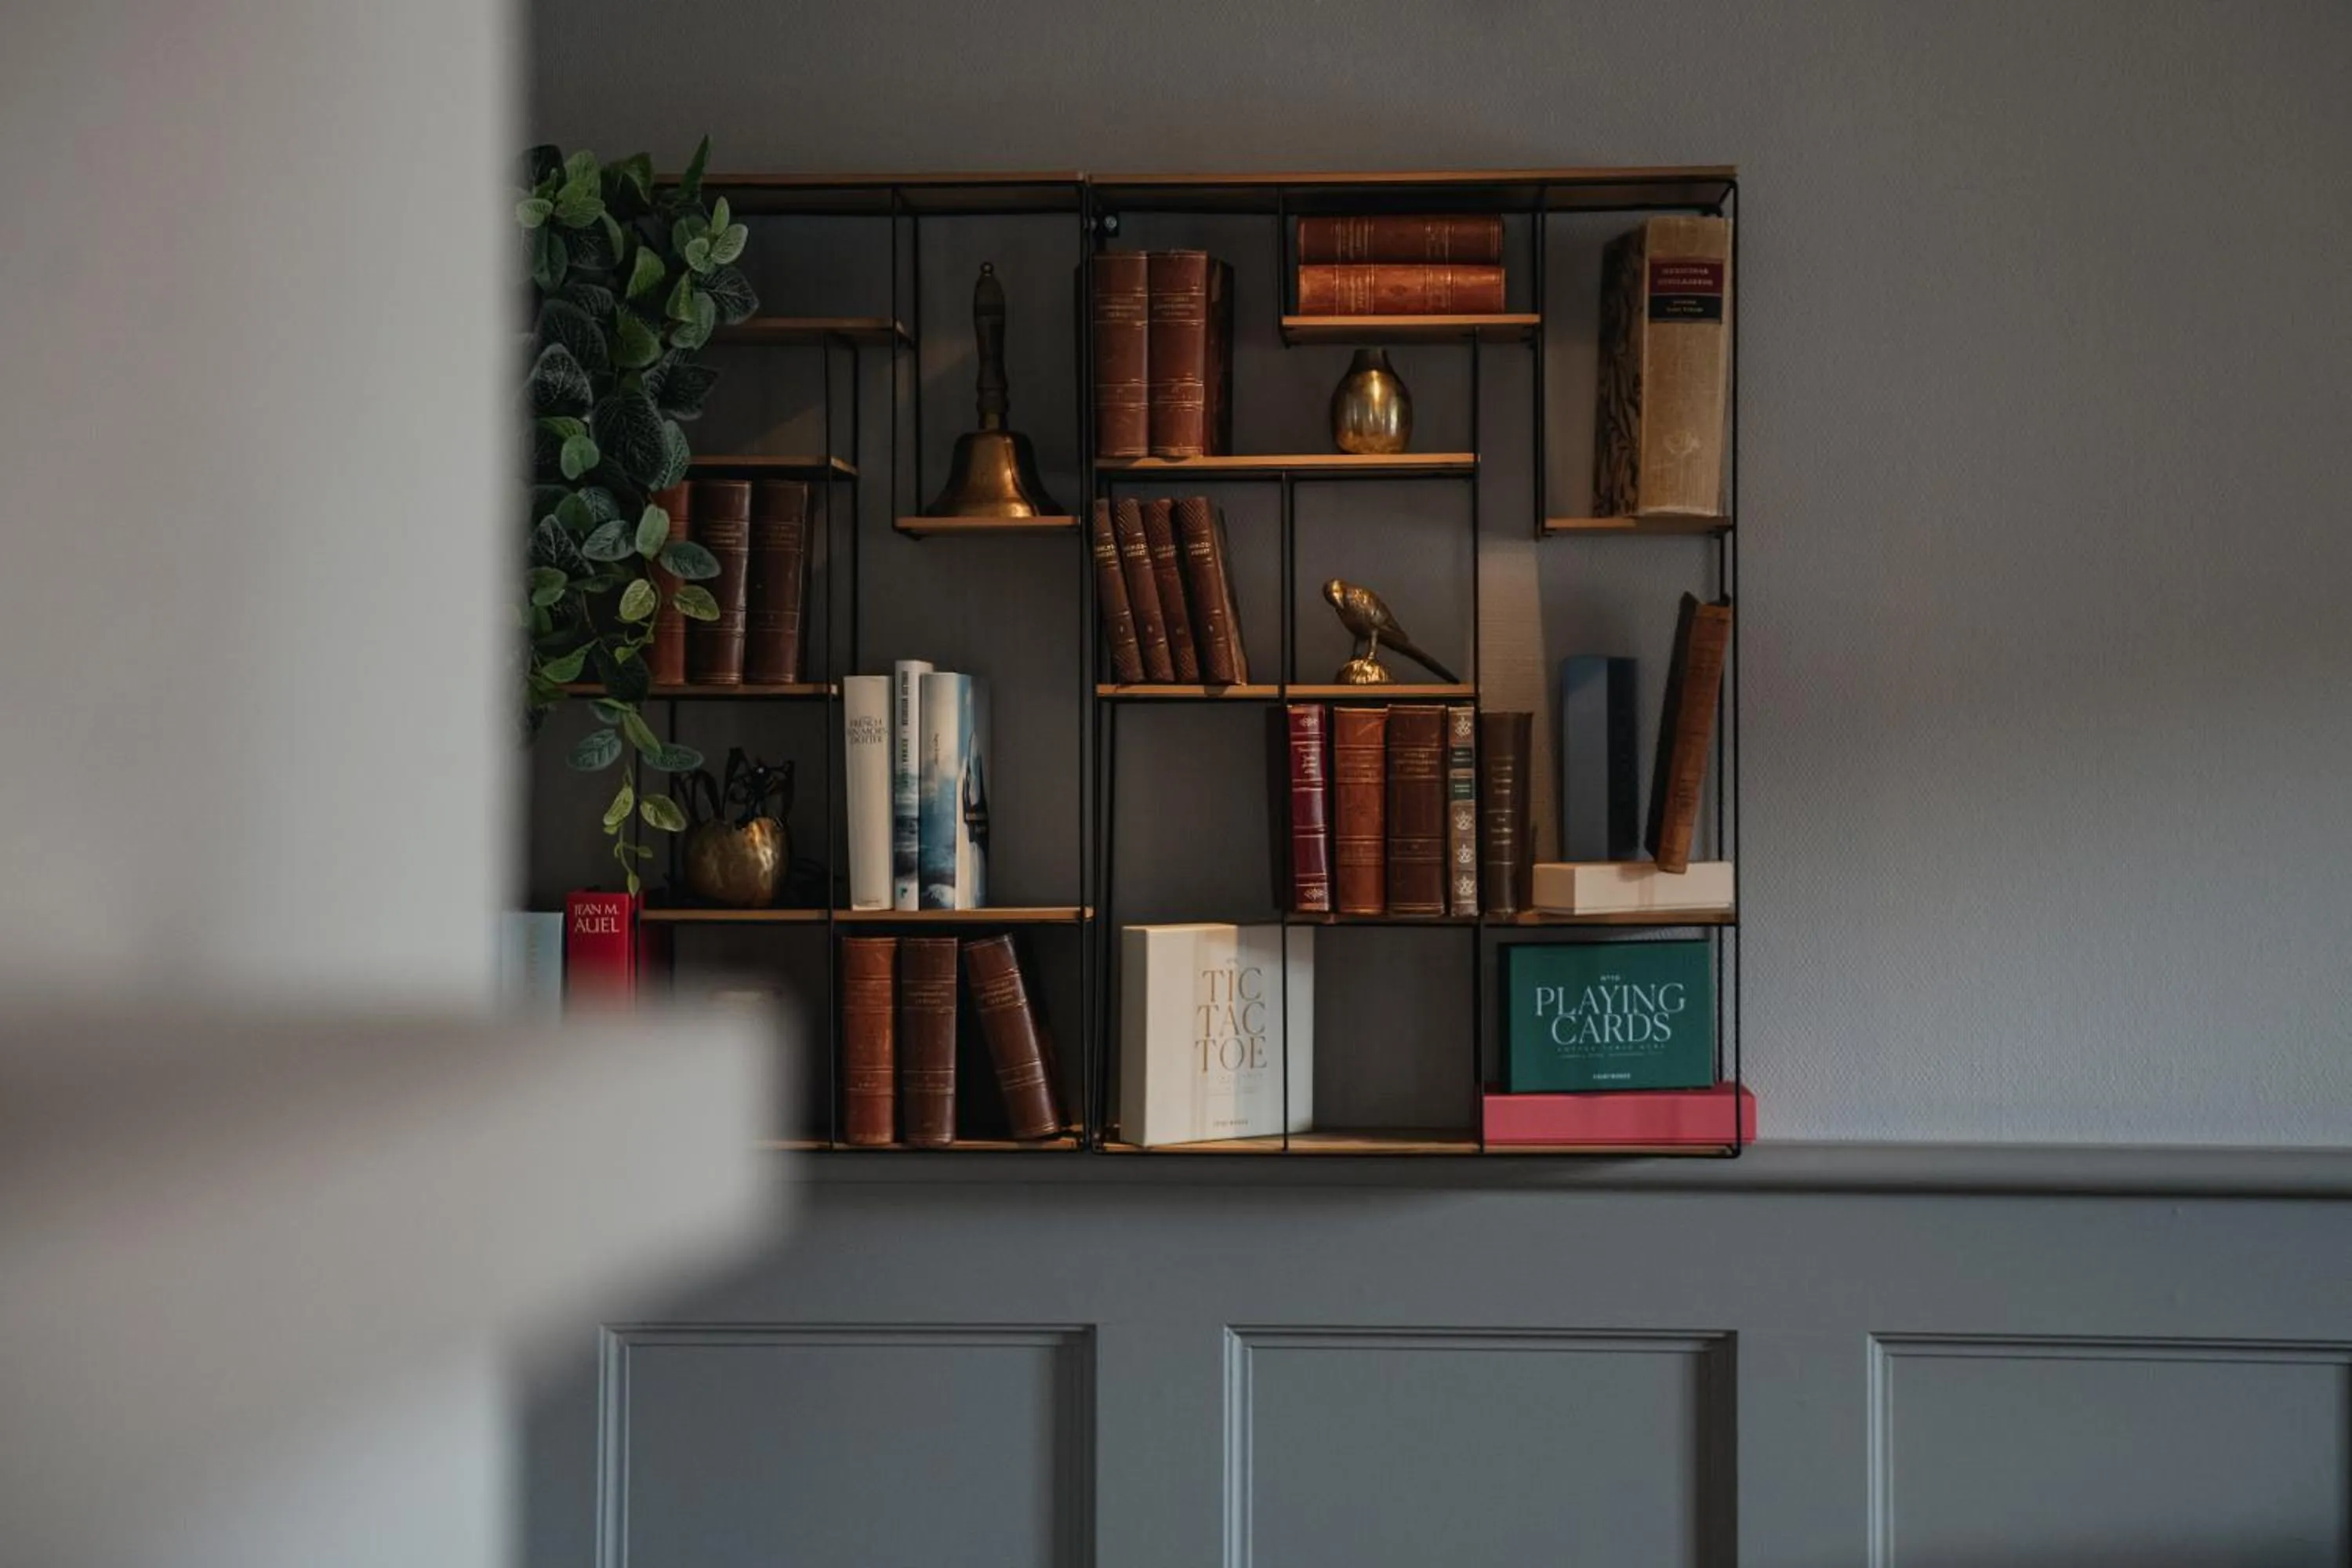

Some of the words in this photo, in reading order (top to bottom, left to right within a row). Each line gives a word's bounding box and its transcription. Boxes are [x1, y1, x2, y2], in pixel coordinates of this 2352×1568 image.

[574, 904, 601, 916] JEAN
[574, 916, 620, 933] AUEL
[1202, 967, 1262, 1003] TIC
[1535, 982, 1686, 1016] PLAYING
[1197, 1003, 1266, 1037] TAC
[1552, 1012, 1672, 1046] CARDS
[1195, 1036, 1268, 1073] TOE
